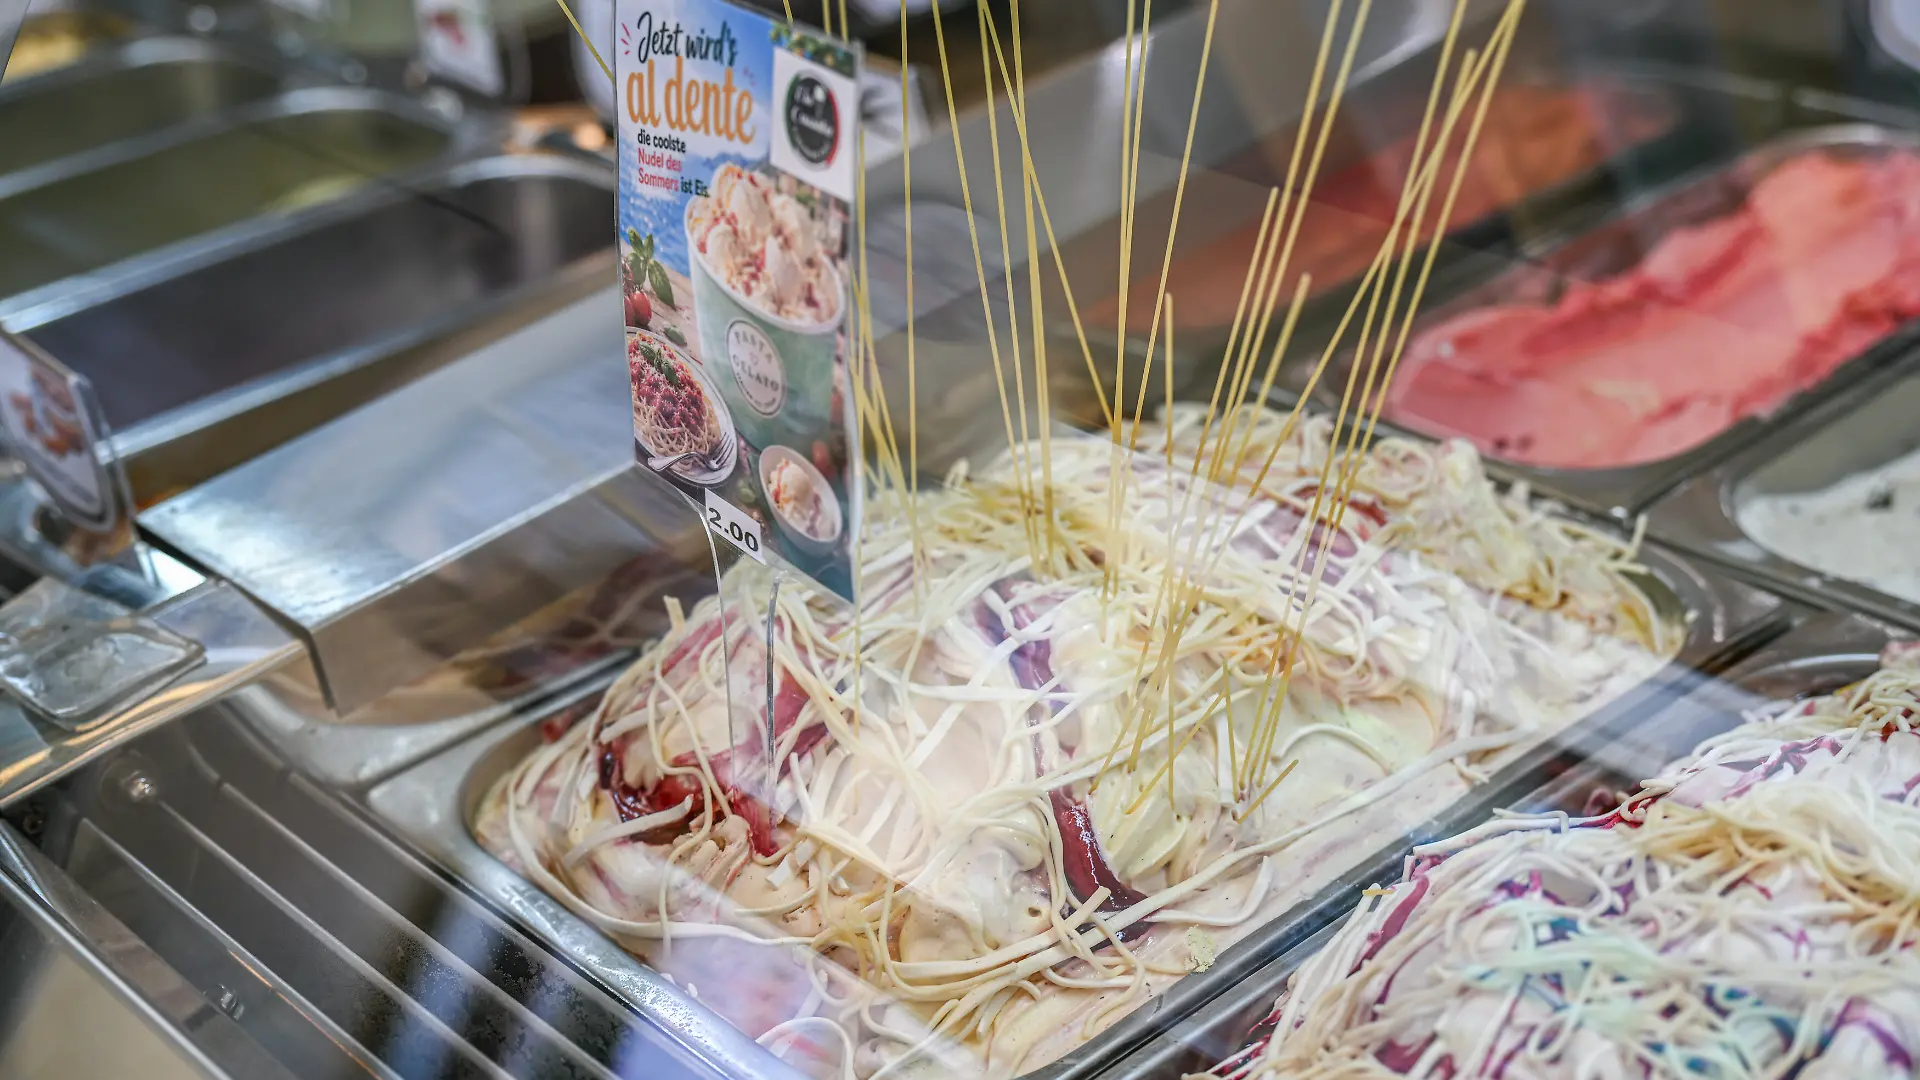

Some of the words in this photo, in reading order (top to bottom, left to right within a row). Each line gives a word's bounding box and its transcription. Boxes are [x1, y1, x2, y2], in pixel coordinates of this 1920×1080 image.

[637, 11, 683, 64] Jetzt
[685, 20, 738, 67] wird's
[627, 58, 661, 128] al
[664, 56, 756, 144] dente
[637, 128, 651, 146] die
[653, 134, 686, 153] coolste
[637, 147, 664, 168] Nudel
[665, 155, 683, 172] des
[638, 167, 679, 192] Sommers
[680, 176, 693, 194] ist
[732, 354, 780, 392] GELATO
[708, 507, 759, 552] 2.00
